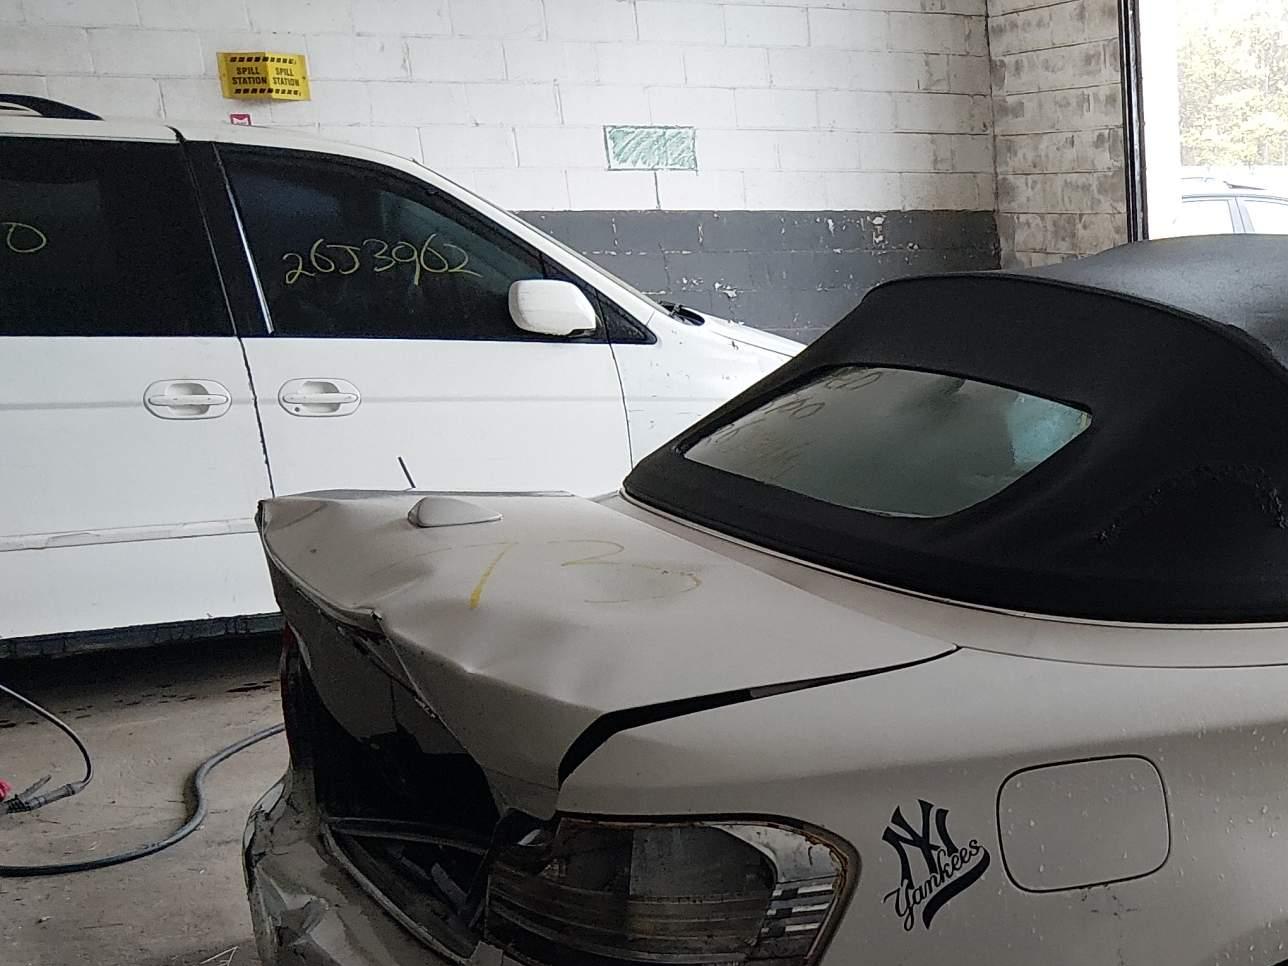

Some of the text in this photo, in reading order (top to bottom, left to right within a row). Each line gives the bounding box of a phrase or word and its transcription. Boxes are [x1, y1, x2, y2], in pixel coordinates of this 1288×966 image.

[236, 66, 260, 75] SPILL
[274, 66, 294, 77] SPILL
[231, 76, 268, 86] STATION
[272, 76, 300, 87] STATION
[882, 838, 981, 932] Yankees
